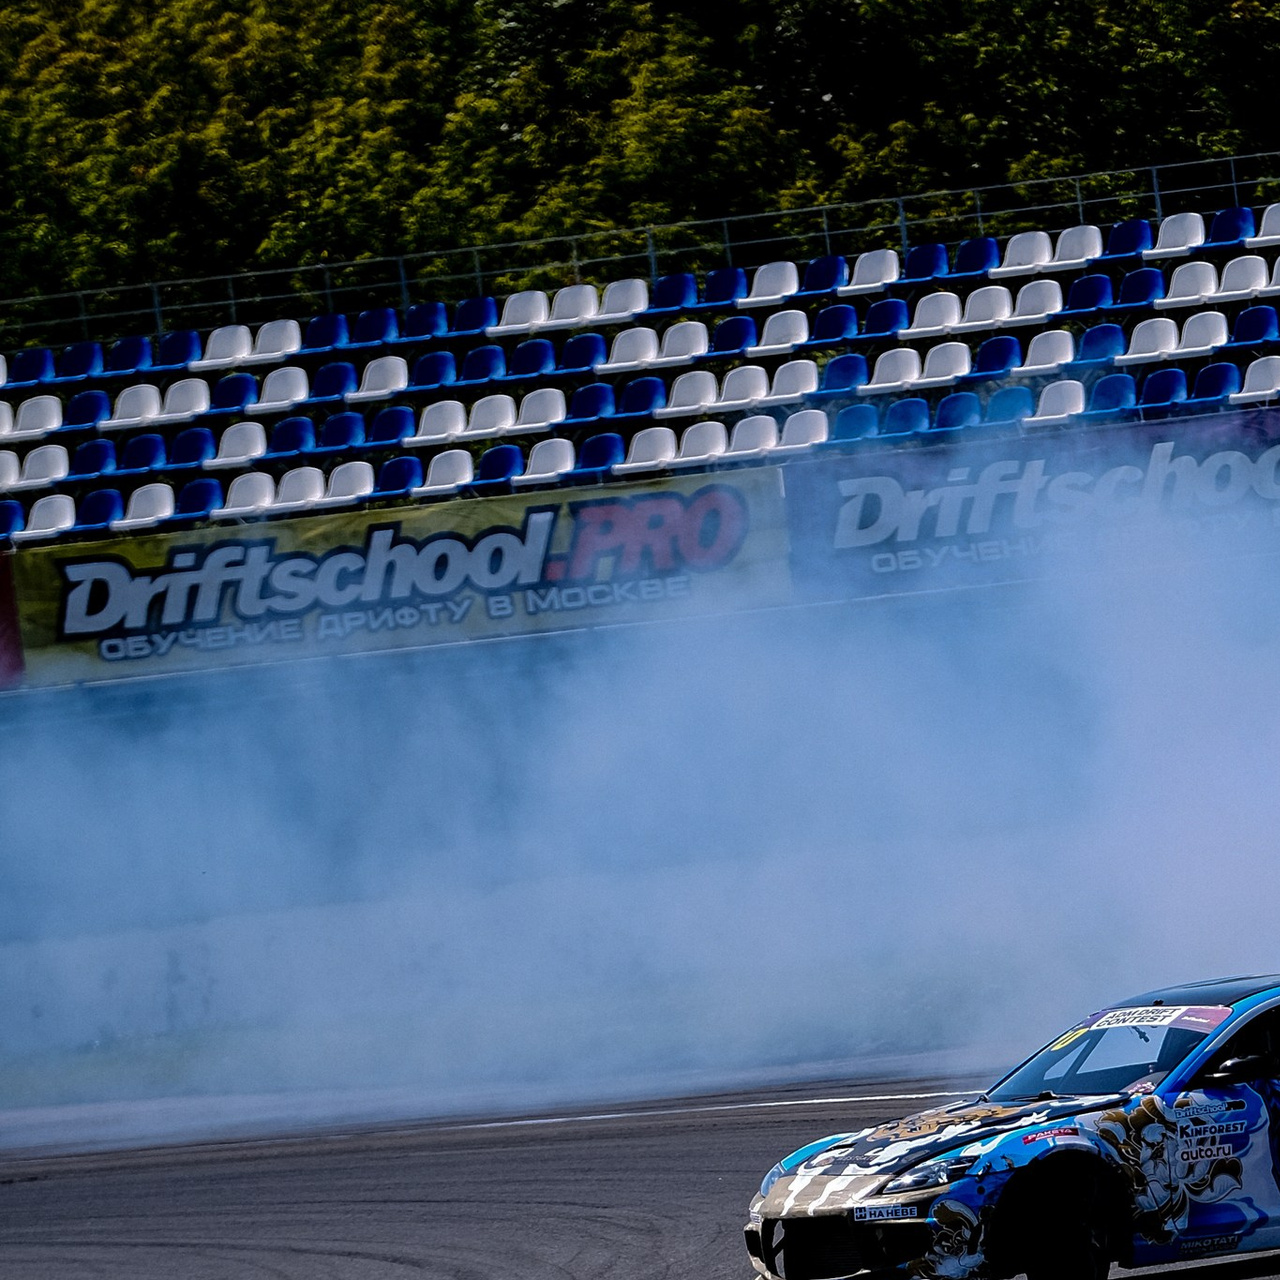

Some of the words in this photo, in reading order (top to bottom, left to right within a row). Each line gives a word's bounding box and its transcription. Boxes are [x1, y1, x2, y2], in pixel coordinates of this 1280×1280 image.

[98, 616, 304, 663] ОБУЧЕНИЕ
[316, 597, 472, 640] ДРИФТУ
[488, 591, 515, 619] В
[1095, 1015, 1173, 1027] CONTEST
[1180, 1121, 1246, 1139] KINFOREST
[1181, 1145, 1231, 1161] auto.ru
